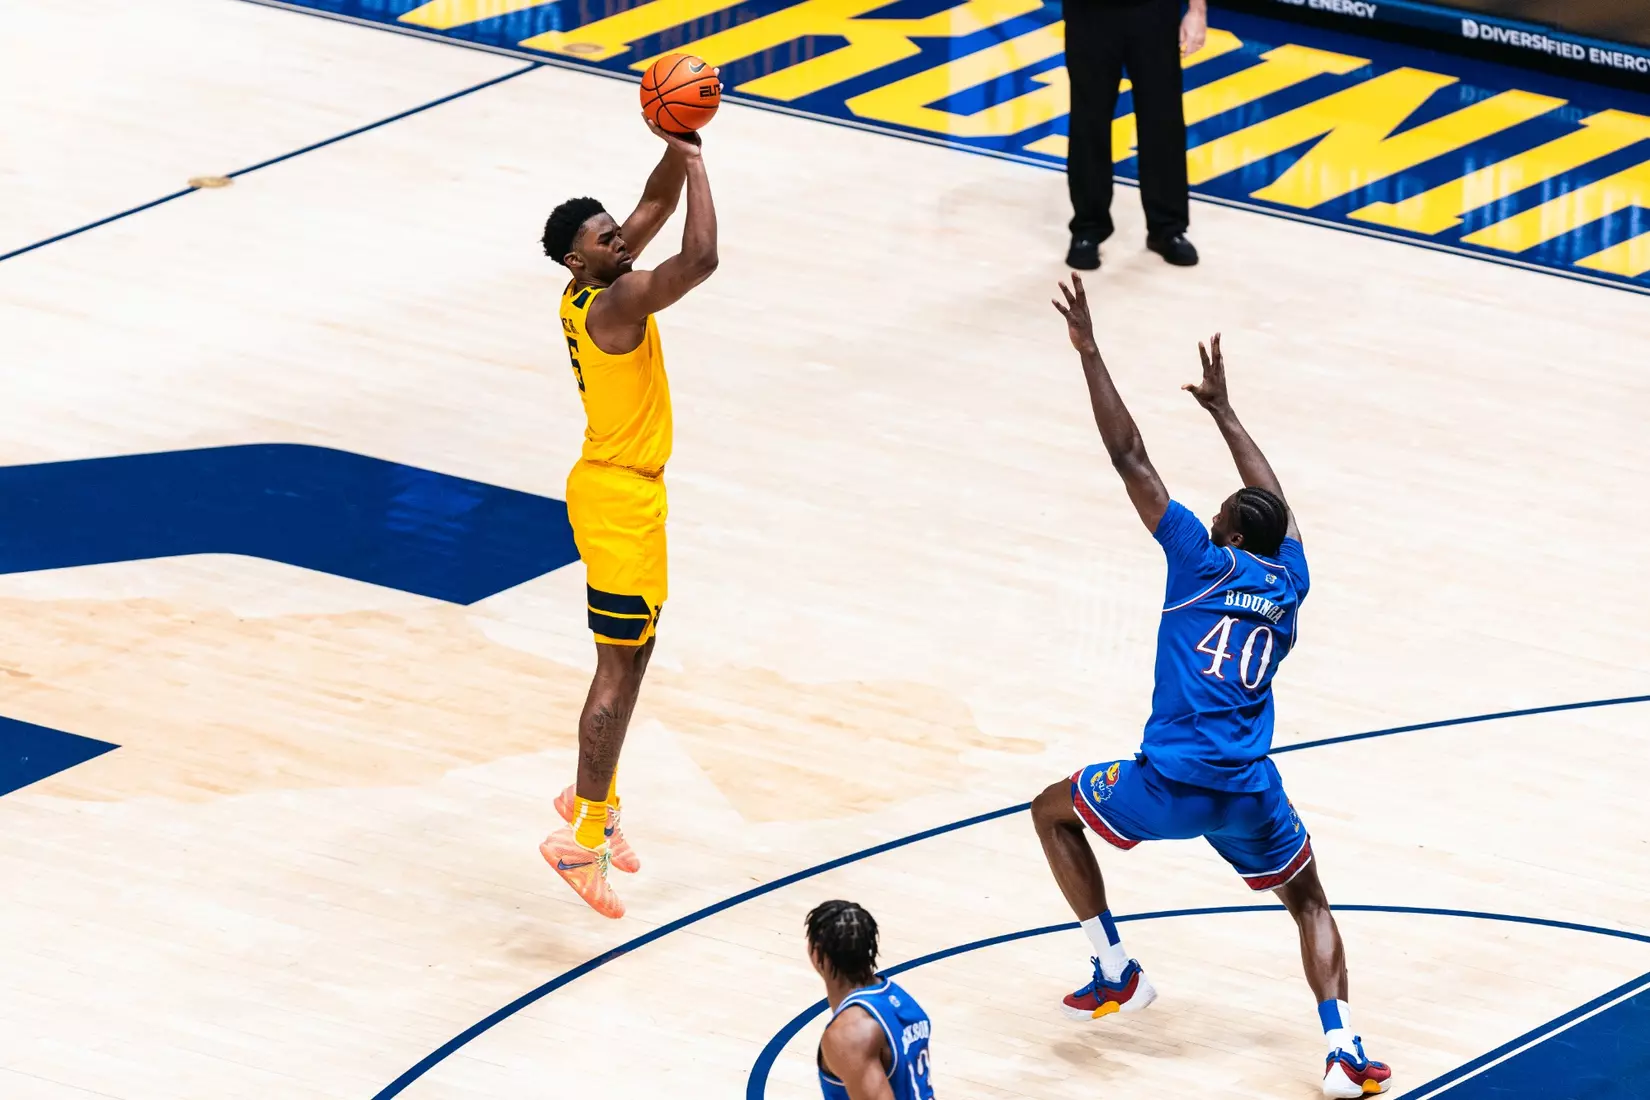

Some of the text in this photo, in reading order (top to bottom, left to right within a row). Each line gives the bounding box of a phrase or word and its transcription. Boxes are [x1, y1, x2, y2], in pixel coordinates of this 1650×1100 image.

[1480, 24, 1586, 60] DIVERSIFIED
[1588, 47, 1650, 73] ENERG
[1224, 589, 1286, 625] BIDUNGA
[1195, 614, 1275, 690] 40
